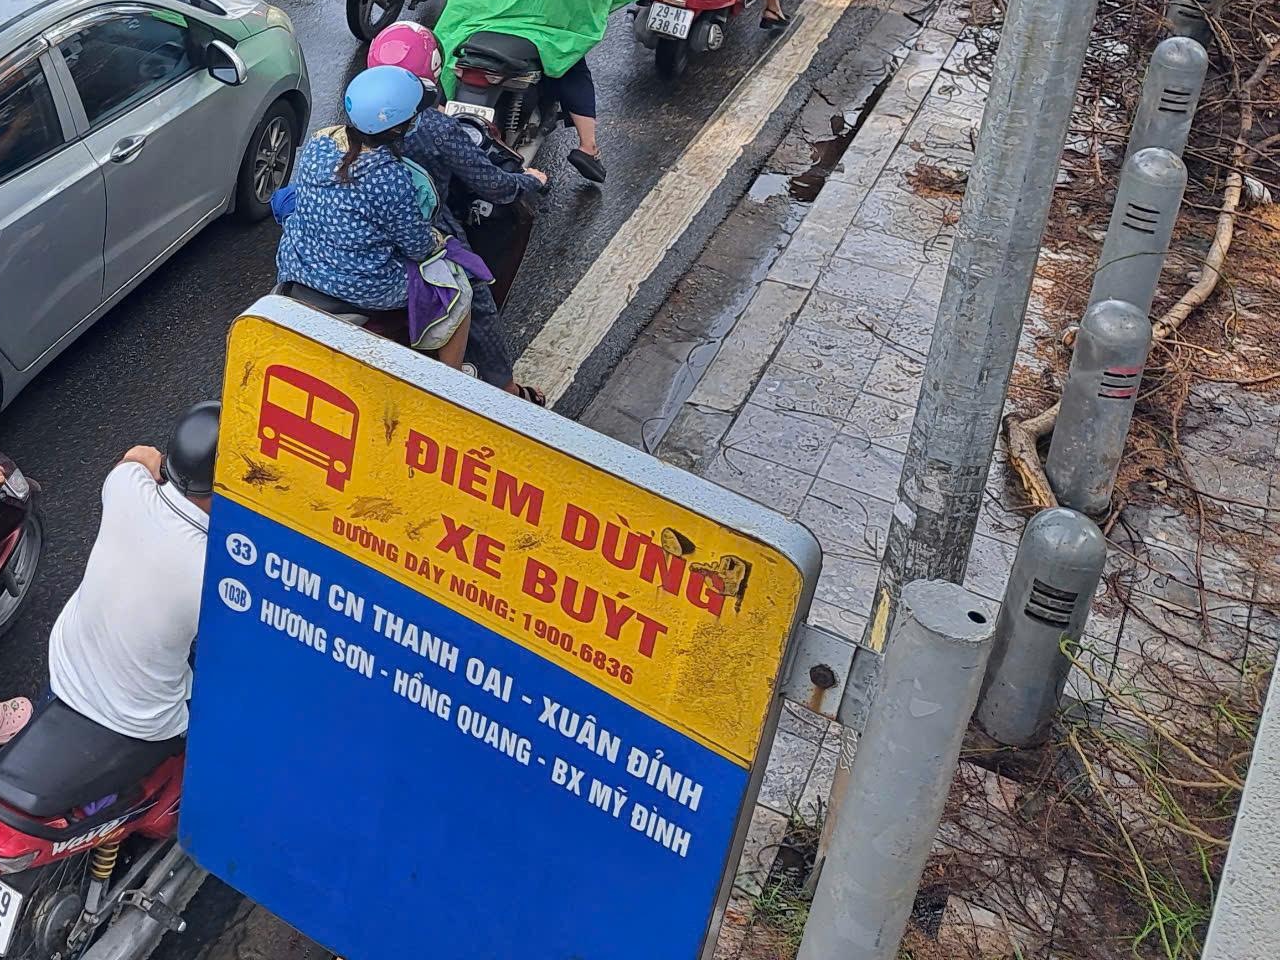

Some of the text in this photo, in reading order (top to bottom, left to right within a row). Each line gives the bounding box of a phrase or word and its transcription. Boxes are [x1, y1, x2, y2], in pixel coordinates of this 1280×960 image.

[650, 17, 686, 36] 238.60
[333, 516, 634, 685] ĐƯỜNG DÂY NÓNG: 1900.6836
[404, 429, 726, 617] ĐIỂM DỪNG
[436, 513, 669, 659] XE BUÝT
[223, 582, 692, 858] 103B HƯƠNG SƠN - HỒNG QUANG - BX MỸ ĐÌNH
[231, 538, 703, 812] 33 CỤM CN THANH OAI - XUÂN ĐỈNH
